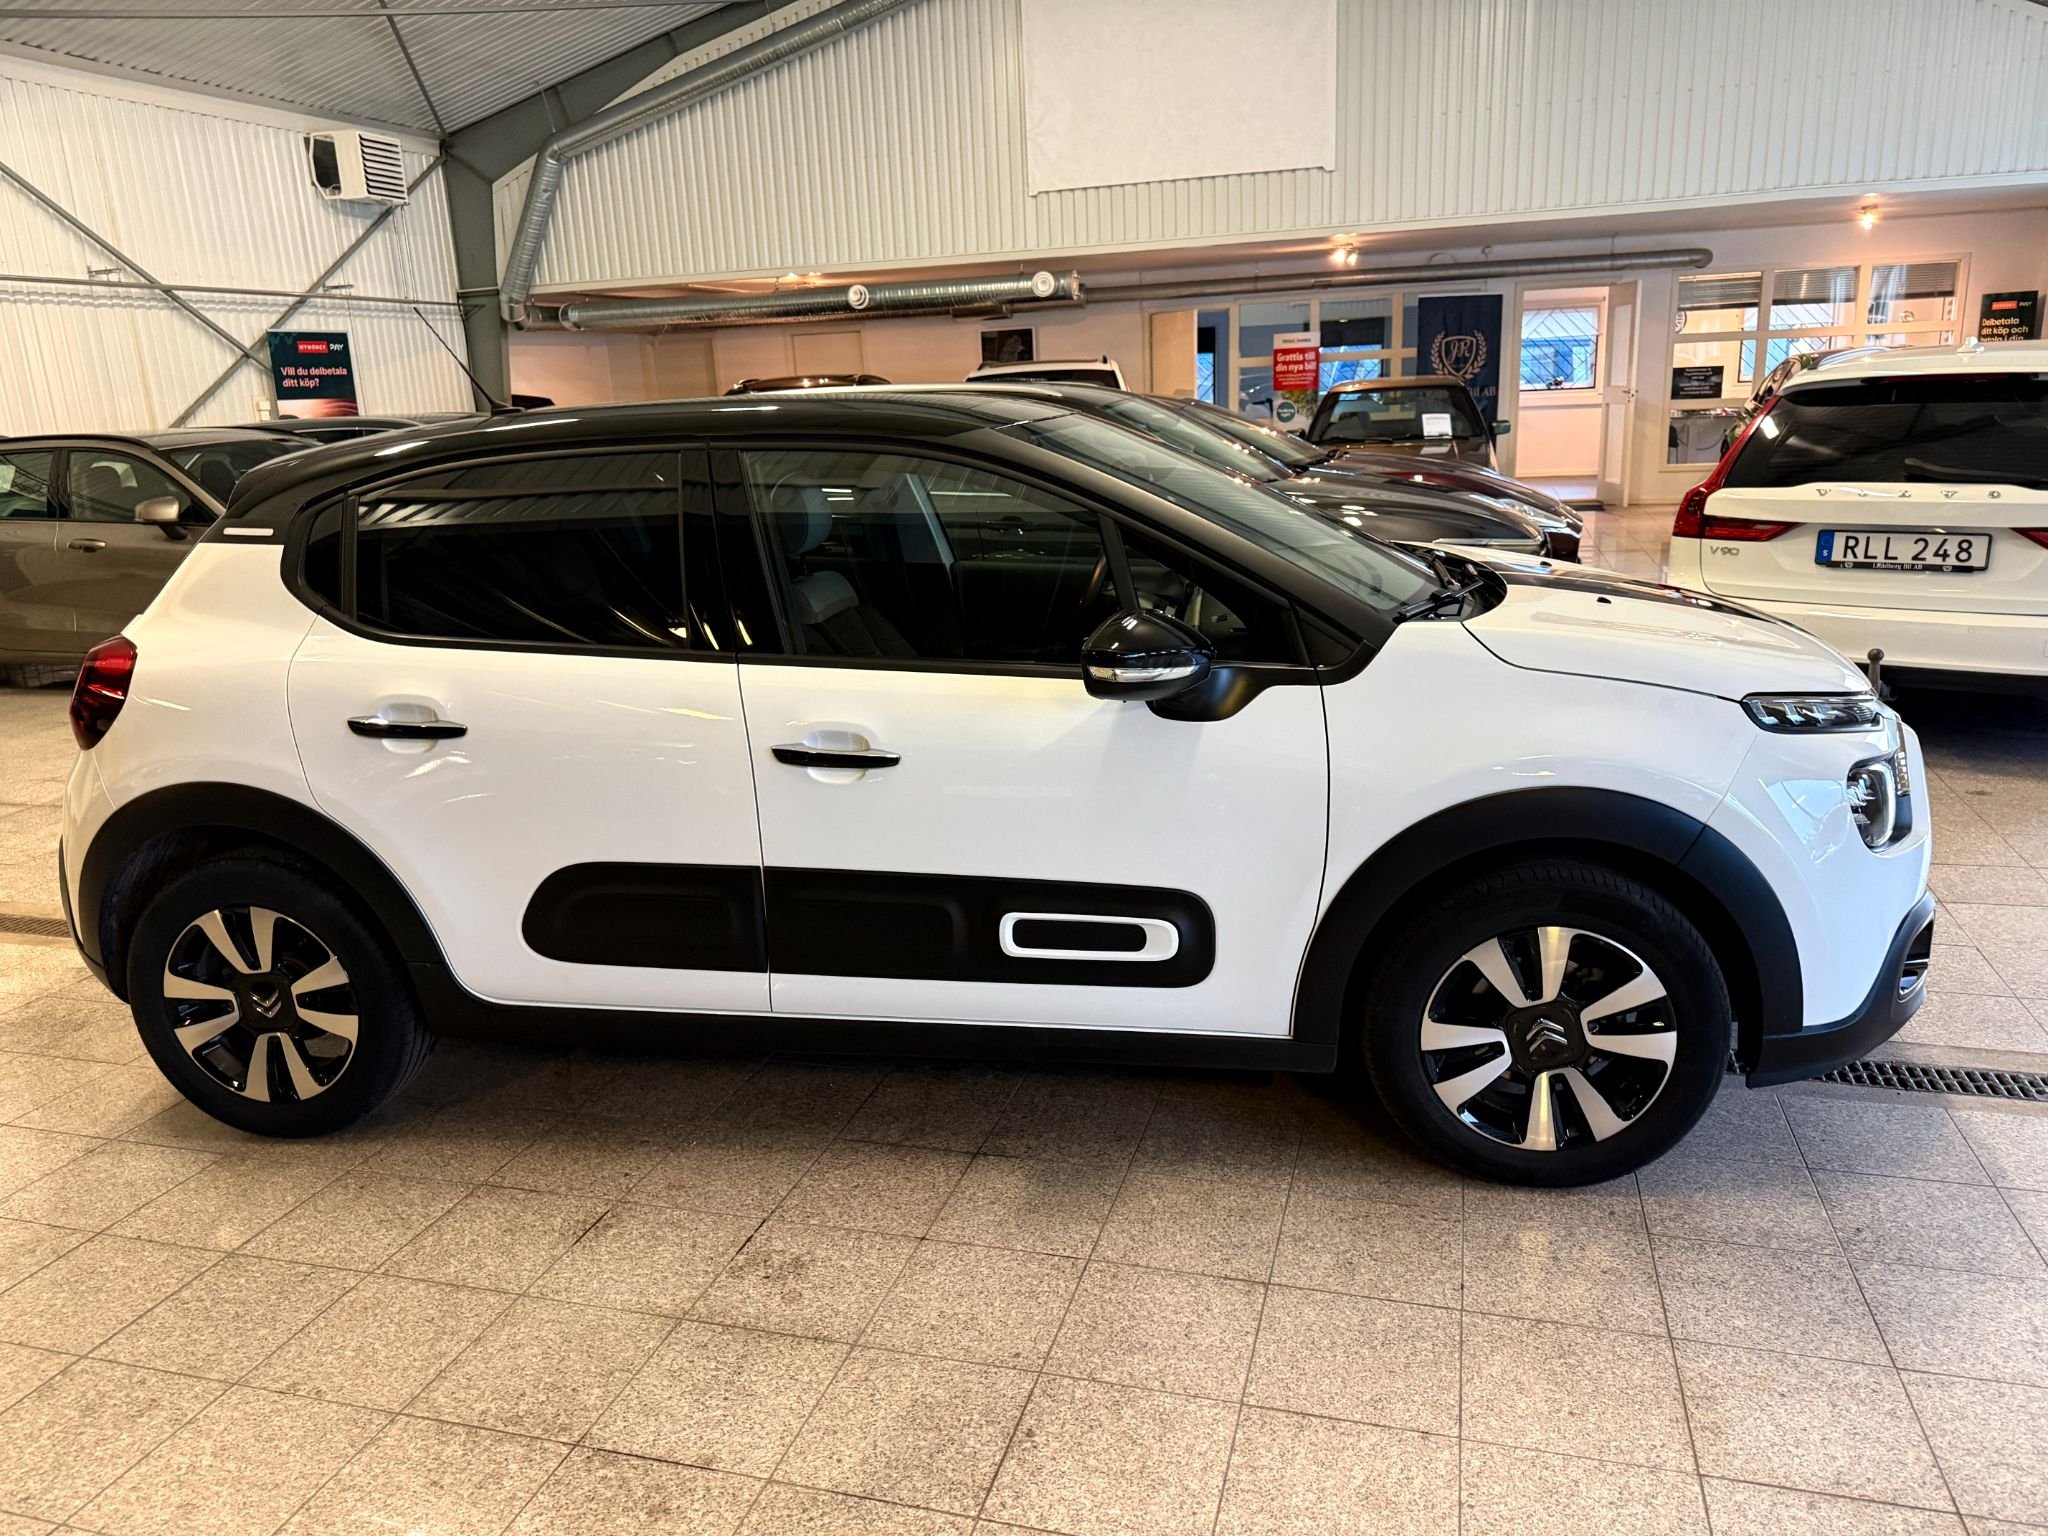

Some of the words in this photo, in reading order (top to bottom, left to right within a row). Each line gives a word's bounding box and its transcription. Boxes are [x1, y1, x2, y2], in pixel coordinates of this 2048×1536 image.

[1982, 317, 2020, 326] Delbetala
[1993, 326, 2010, 335] köp
[2011, 325, 2029, 333] och
[1276, 352, 1304, 362] Grattis
[1304, 351, 1316, 360] till
[1448, 340, 1471, 364] JR
[280, 366, 296, 376] Vill
[296, 366, 309, 376] du
[309, 366, 348, 376] delbetala
[1275, 364, 1288, 372] din
[1288, 364, 1304, 373] nya
[282, 378, 299, 388] ditt
[299, 378, 320, 389] köp?
[1482, 386, 1496, 397] AB
[1709, 545, 1741, 557] V90
[1821, 549, 1829, 557] S
[1842, 535, 1899, 561] RLL
[1910, 537, 1974, 563] 248
